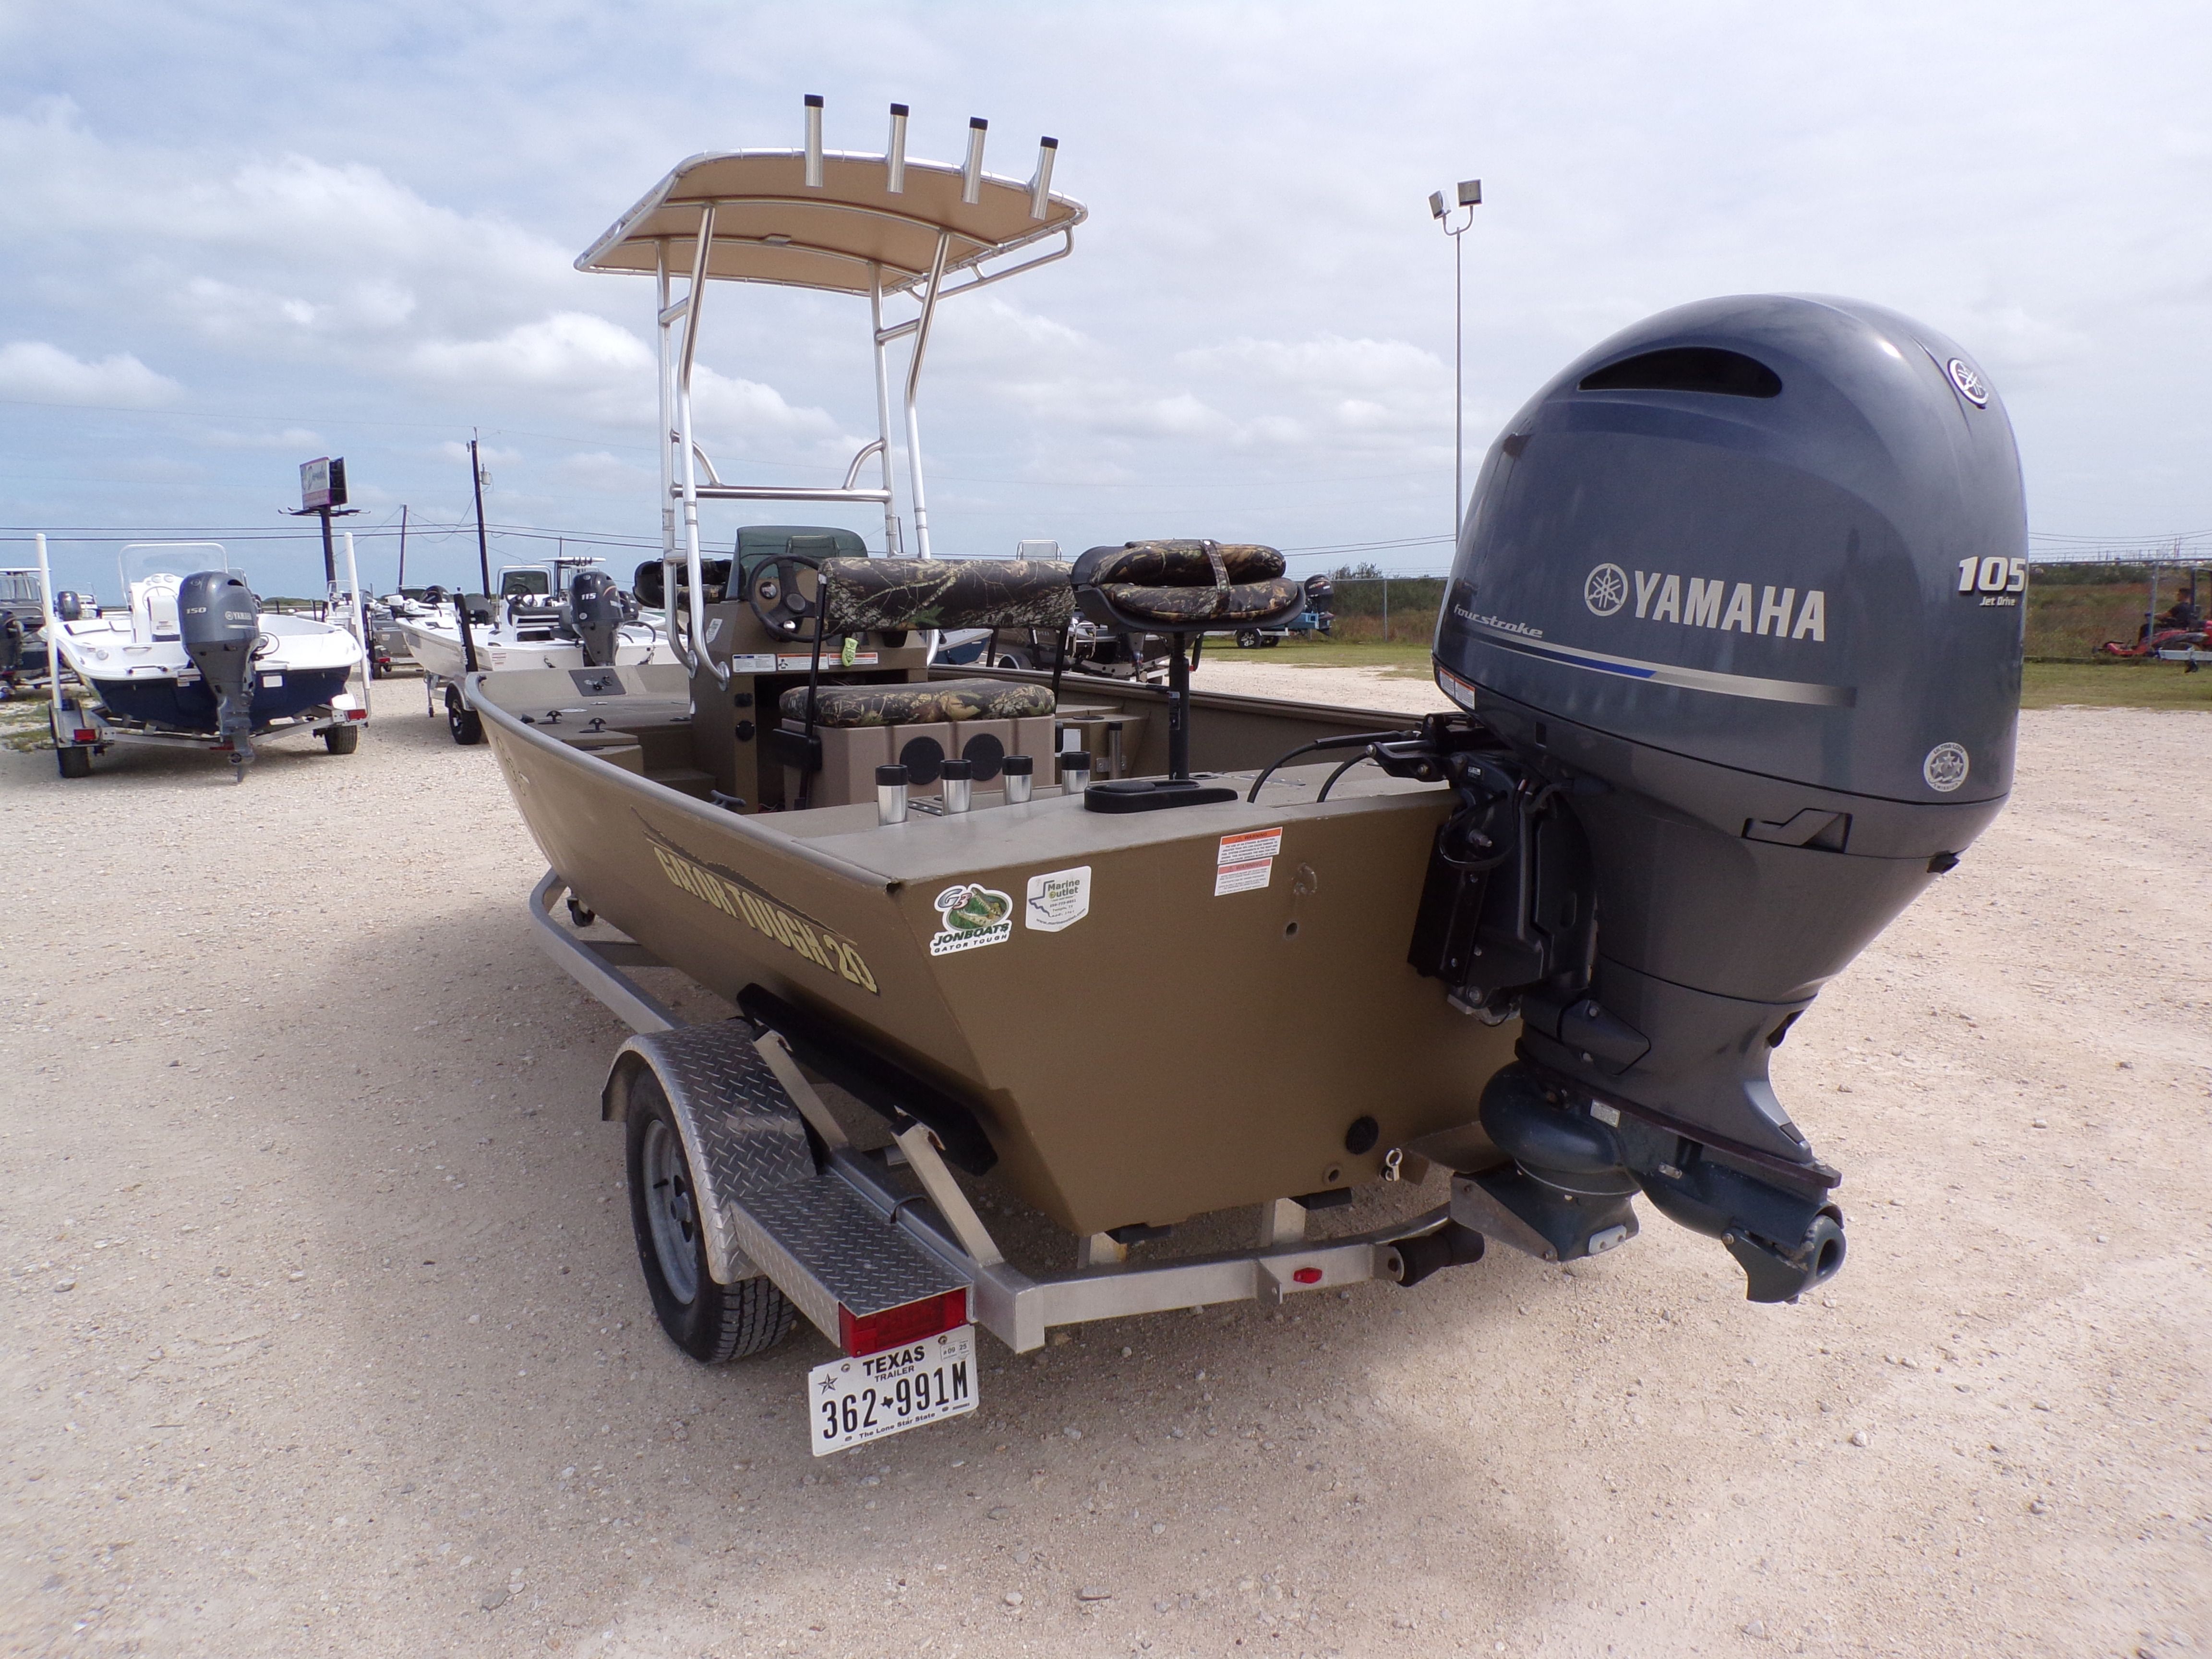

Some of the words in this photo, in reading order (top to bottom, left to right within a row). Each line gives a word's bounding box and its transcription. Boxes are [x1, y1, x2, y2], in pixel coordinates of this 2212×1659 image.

[1959, 556, 2025, 591] 105
[1635, 570, 1825, 641] YAMAHA
[1979, 596, 1996, 606] Jet
[1997, 596, 2016, 606] Drive
[1048, 879, 1080, 891] Marine
[1048, 887, 1079, 899] Outlet
[938, 888, 972, 910] G3
[654, 846, 738, 919] GATOR
[723, 881, 836, 973] TOUGH
[823, 934, 878, 994] 20
[933, 923, 1010, 947] JONBOATS
[934, 942, 968, 953] GATOR
[974, 934, 1007, 945] TOUGH
[863, 1346, 925, 1376] TEXAS
[875, 1365, 914, 1382] TRAILER
[859, 1431, 874, 1439] The
[876, 1424, 895, 1434] Lone
[897, 1418, 914, 1427] Star
[915, 1412, 936, 1422] State
